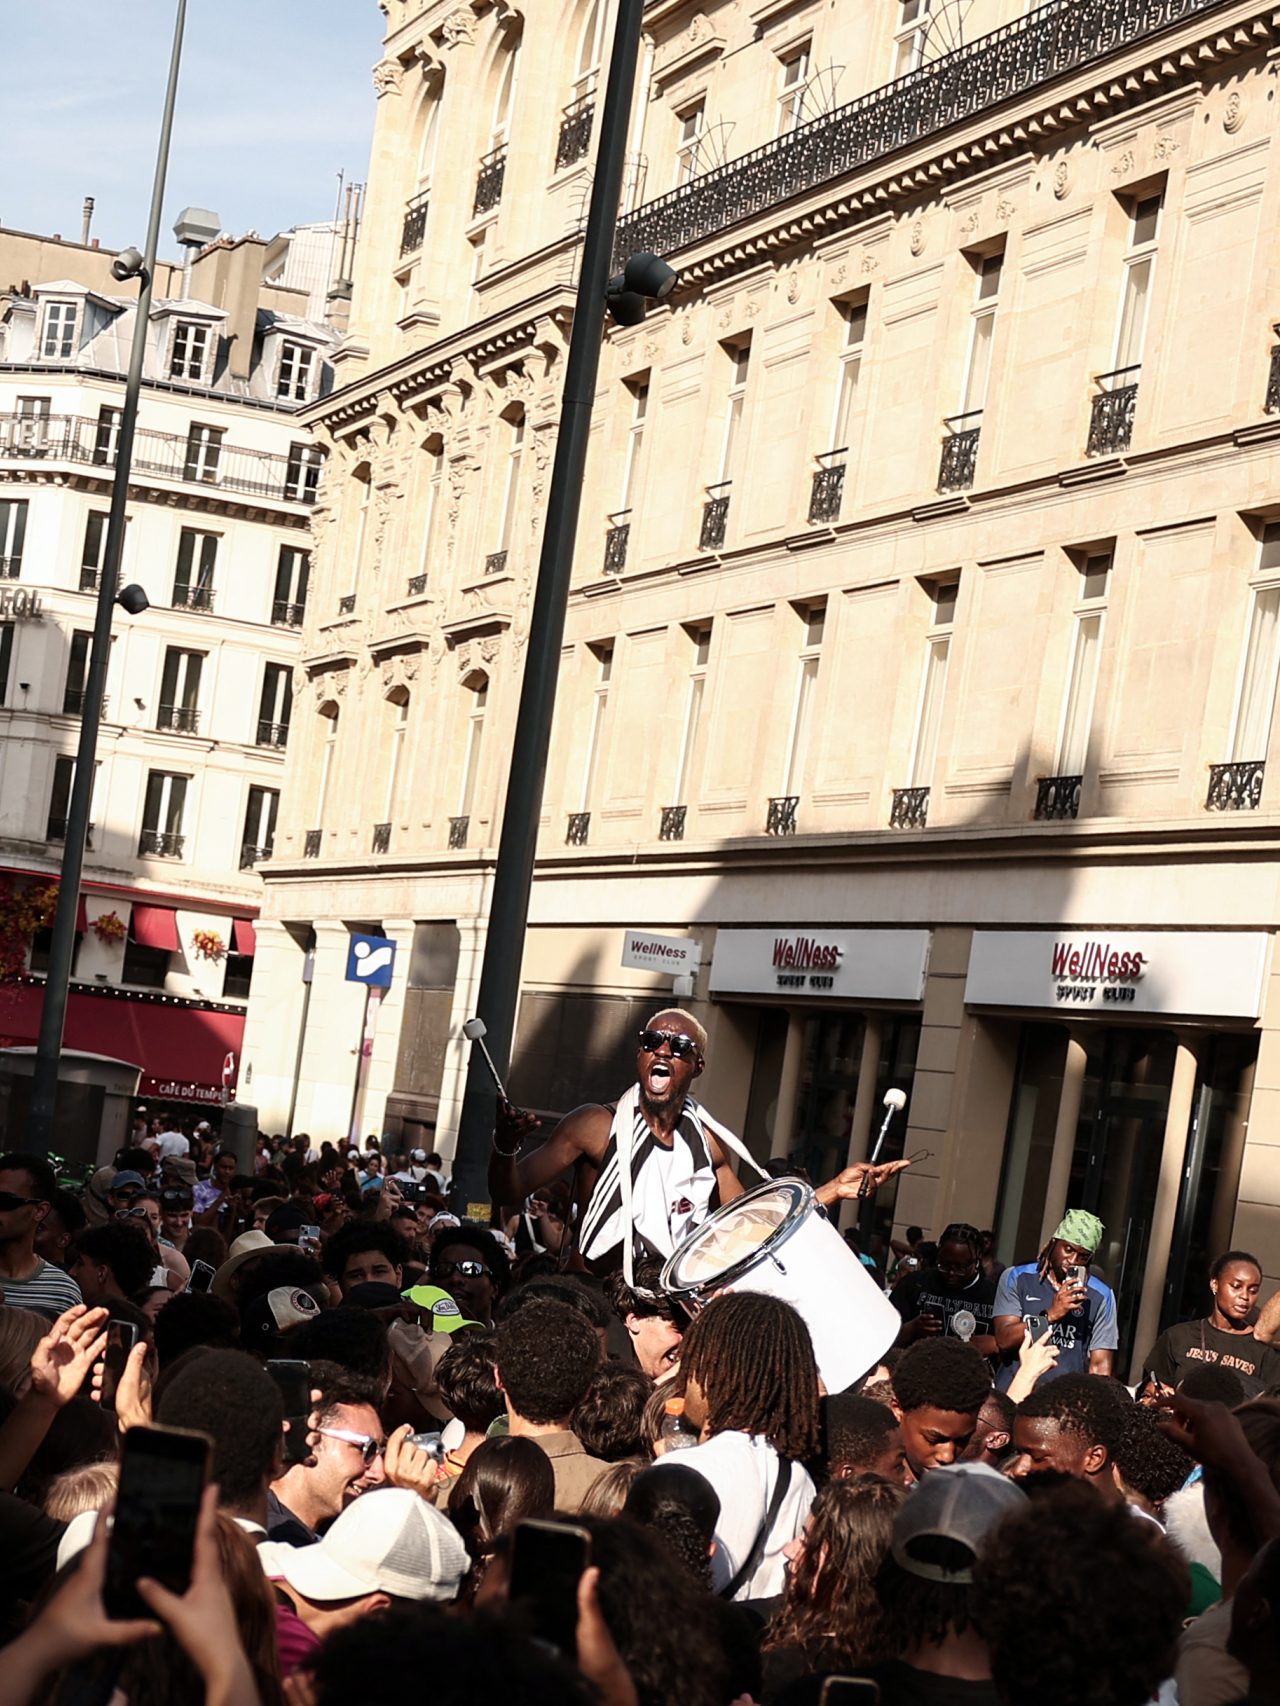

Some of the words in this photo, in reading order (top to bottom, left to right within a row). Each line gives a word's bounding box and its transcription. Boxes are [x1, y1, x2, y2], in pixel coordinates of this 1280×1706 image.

[631, 940, 687, 959] WellNess
[772, 937, 840, 967] WellNess
[1051, 942, 1143, 977] WellNess
[181, 1086, 194, 1097] DU
[195, 1088, 222, 1100] TEMPL
[1220, 1354, 1256, 1375] SAVES
